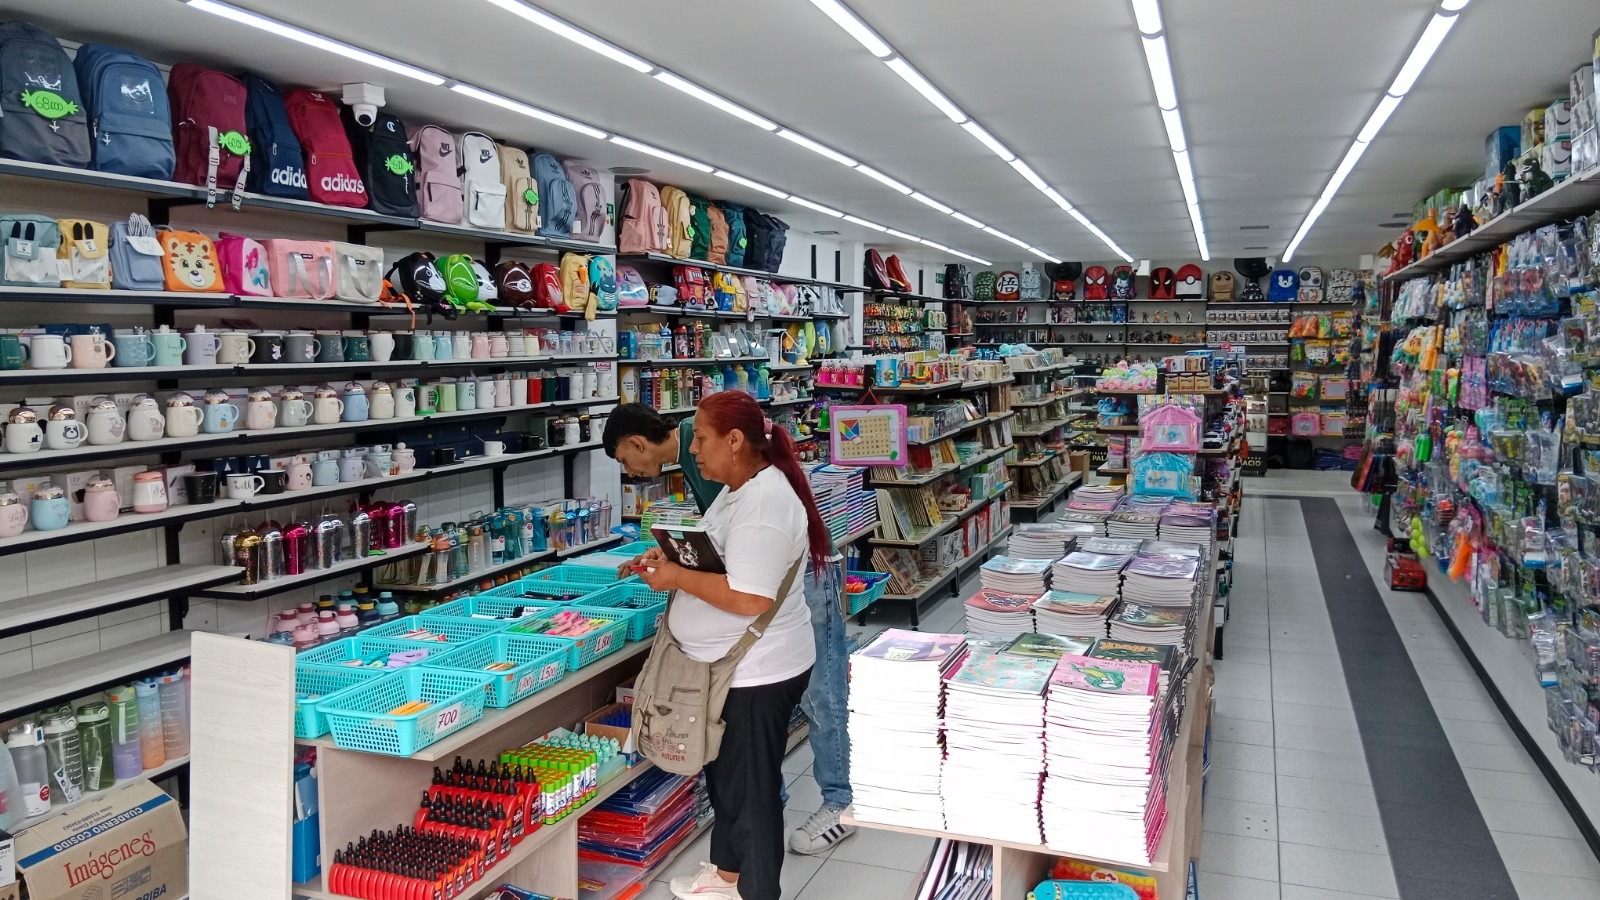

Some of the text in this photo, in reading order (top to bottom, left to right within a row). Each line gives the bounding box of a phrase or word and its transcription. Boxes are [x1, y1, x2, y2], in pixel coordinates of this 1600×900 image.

[271, 166, 308, 189] adida
[321, 173, 365, 193] adidas
[997, 276, 1018, 292] 悟
[1242, 459, 1261, 467] ACIO
[438, 709, 458, 728] 700
[53, 807, 143, 853] CUADERNO COSIDO
[63, 832, 155, 888] Imágenes
